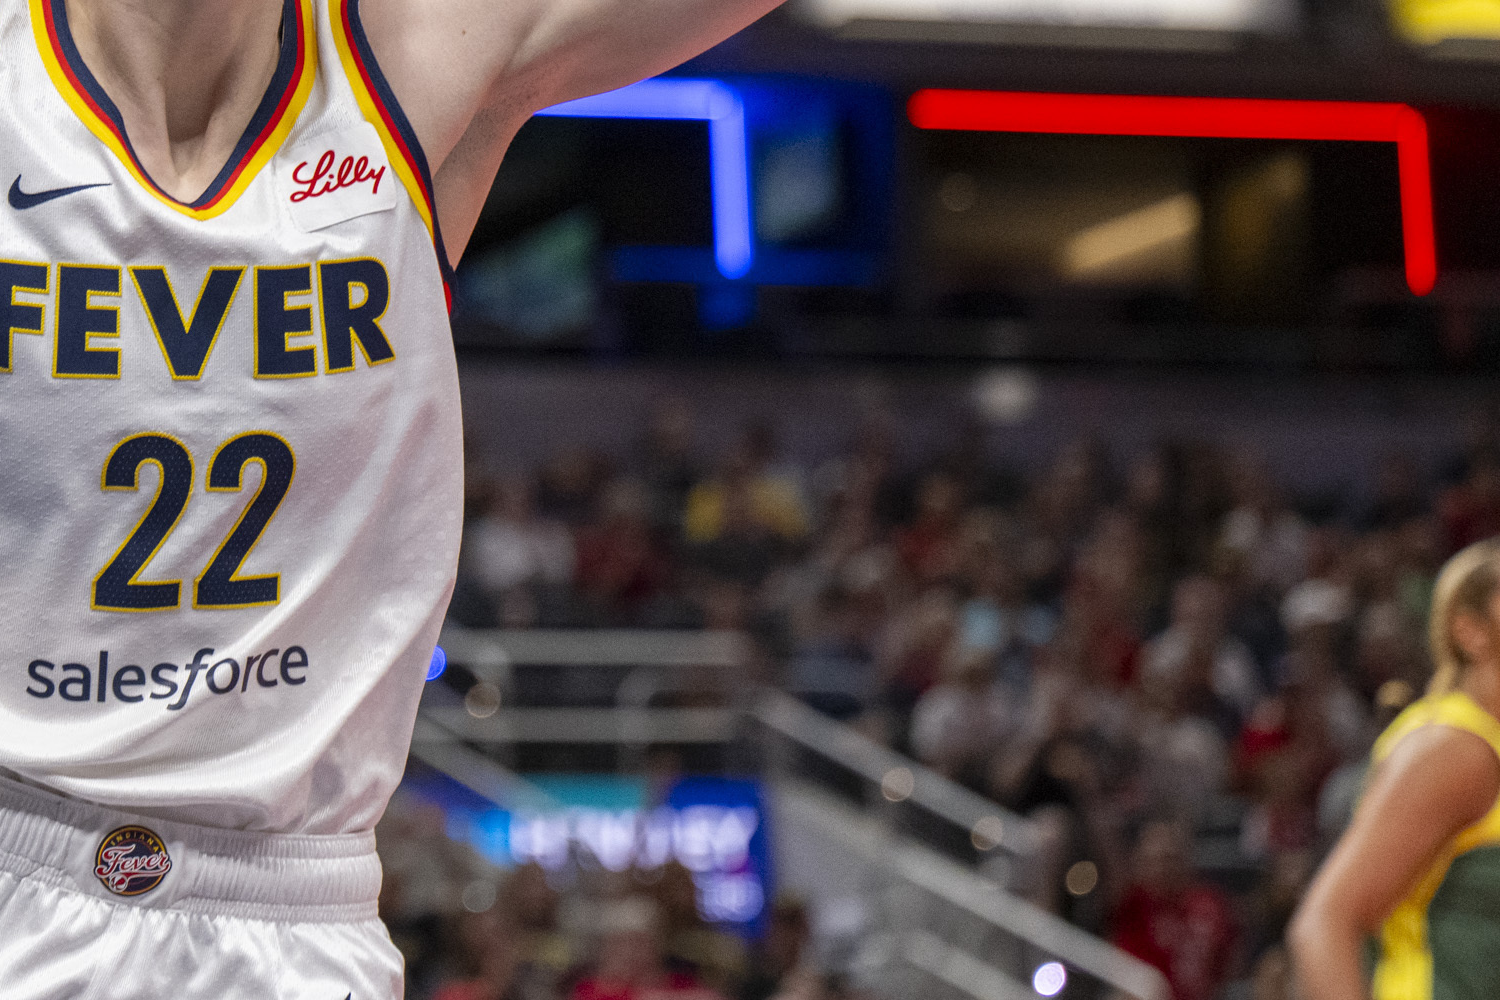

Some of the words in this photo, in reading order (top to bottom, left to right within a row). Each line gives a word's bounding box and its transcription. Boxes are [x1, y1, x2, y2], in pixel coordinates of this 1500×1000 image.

[290, 149, 387, 203] Lilly
[90, 429, 297, 612] 22
[26, 645, 309, 710] salesforce
[95, 843, 172, 877] Fever
[110, 831, 160, 853] INDIANA
